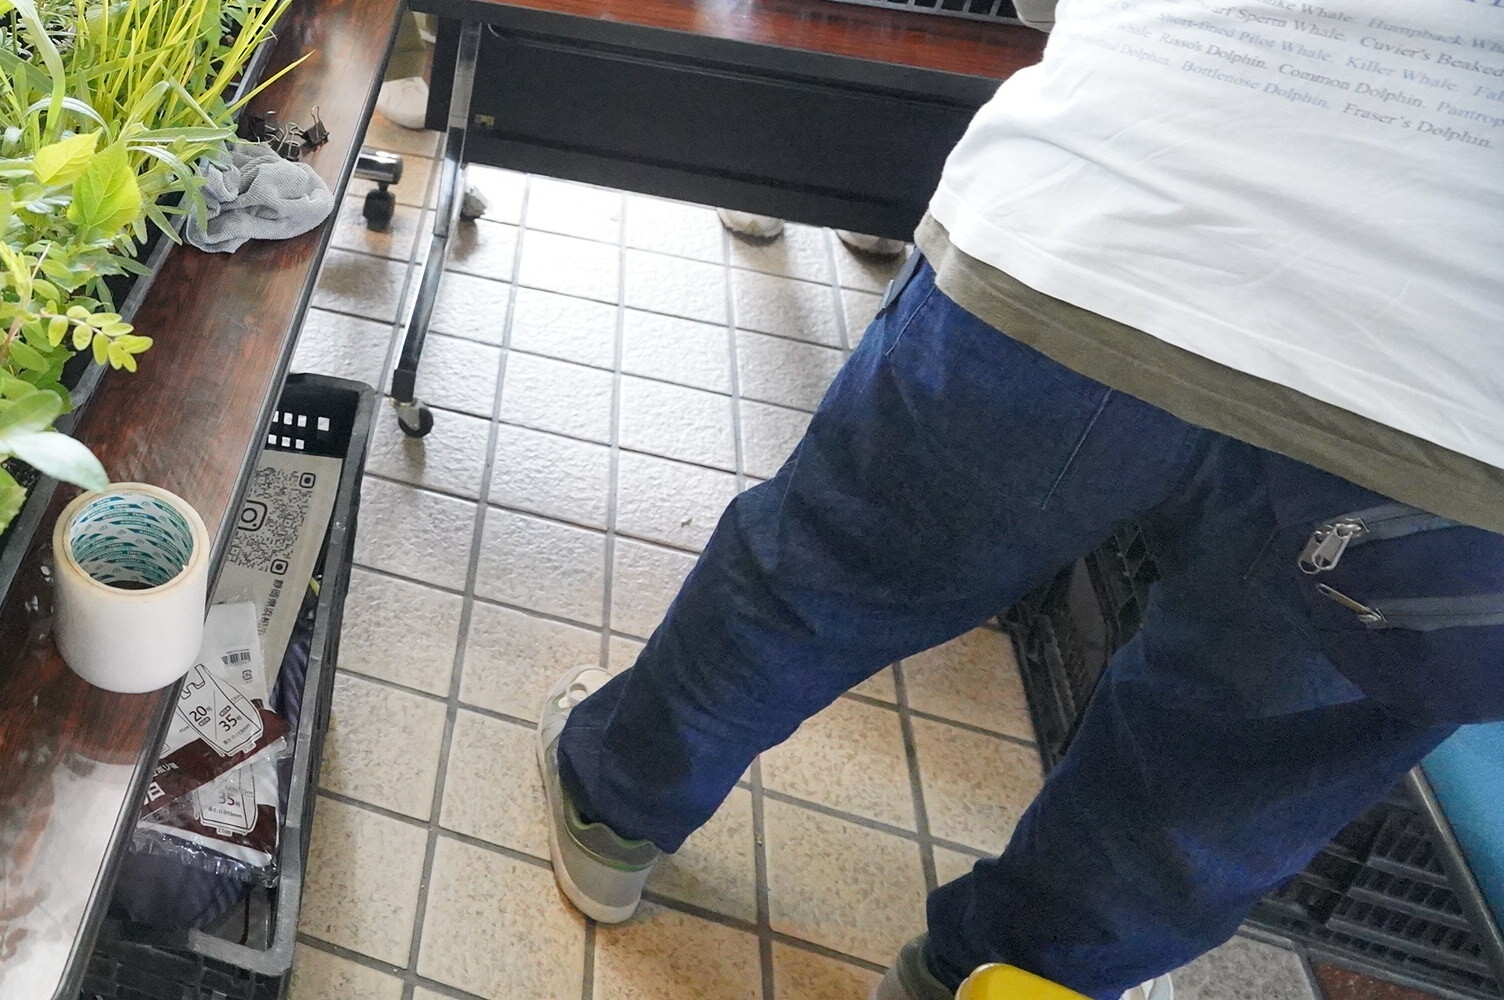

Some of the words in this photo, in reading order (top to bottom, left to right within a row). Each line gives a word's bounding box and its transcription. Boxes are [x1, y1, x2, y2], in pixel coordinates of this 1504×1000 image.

[1237, 5, 1289, 34] Sperm
[1359, 35, 1433, 63] Cuvier's
[1278, 61, 1352, 92] Common
[1353, 81, 1429, 111] Dolphin.
[1345, 54, 1398, 78] Killer
[1180, 59, 1261, 91] Bottlenose
[1342, 100, 1413, 129] Fraser's
[1416, 117, 1495, 150] Dolphin.
